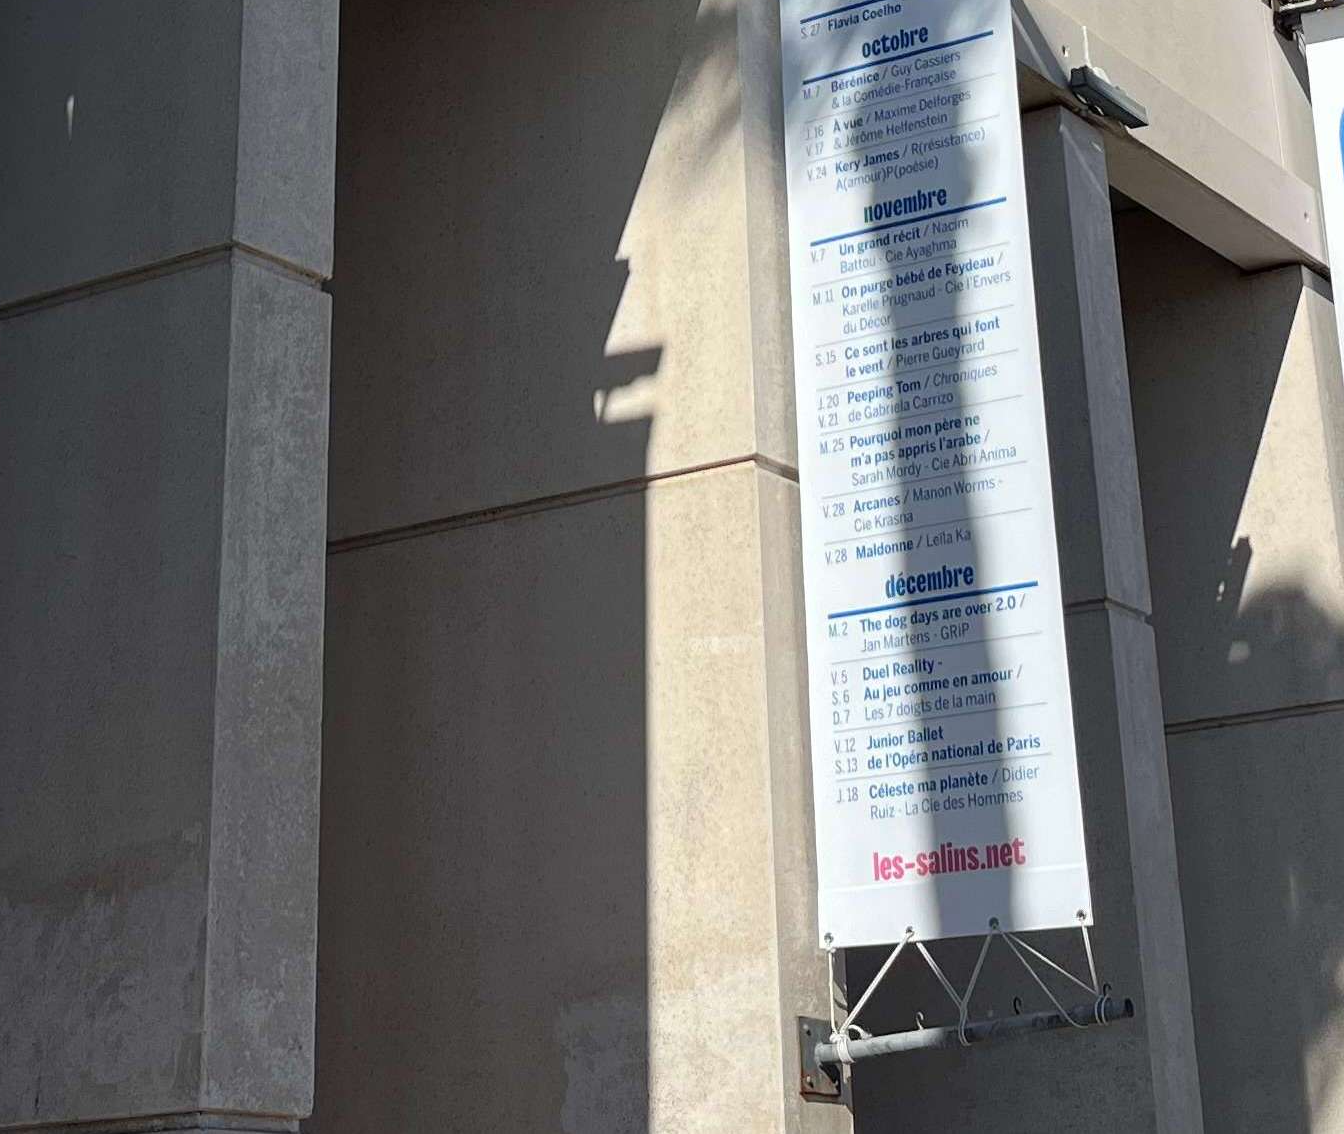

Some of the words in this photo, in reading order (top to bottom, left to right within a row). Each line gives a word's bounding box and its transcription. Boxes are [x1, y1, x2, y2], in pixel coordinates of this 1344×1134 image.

[827, 14, 859, 31] Flavia
[861, 3, 901, 21] Coelho
[861, 26, 928, 58] octobre
[830, 72, 879, 93] Bérénice
[890, 64, 911, 77] Guy
[913, 51, 960, 71] Cassiers
[843, 117, 863, 130] vue
[873, 104, 916, 122] Maxime
[844, 128, 883, 147] Jérôme
[835, 159, 860, 174] Kery
[862, 149, 899, 167] James
[863, 188, 946, 223] novembre
[838, 242, 854, 256] Un
[857, 235, 890, 254] grand
[893, 226, 920, 243] récit
[931, 217, 968, 235] Nacim
[884, 249, 903, 263] Cie
[841, 285, 857, 298] On
[860, 279, 893, 297] purge
[895, 268, 924, 286] bébé
[927, 266, 942, 279] de
[944, 256, 994, 276] Feydeau
[841, 297, 878, 316] Karelle
[944, 279, 964, 294] Cie
[966, 270, 1011, 289] l'Envers
[842, 320, 856, 334] du
[859, 314, 890, 331] Décor
[844, 346, 859, 360] Ce
[862, 339, 887, 356] sont
[891, 337, 908, 350] les
[911, 329, 949, 346] arbres
[952, 324, 971, 338] qui
[974, 315, 1000, 332] font
[845, 365, 856, 378] le
[858, 359, 883, 375] vent
[895, 351, 929, 367] Pierre
[847, 385, 893, 404] Peeping
[895, 380, 921, 394] Tom
[932, 363, 997, 387] Chroniques
[847, 409, 861, 423] de
[863, 399, 910, 419] Gabriela
[912, 392, 953, 409] Carrizo
[849, 426, 901, 449] Pourquoi
[904, 423, 931, 438] mon
[934, 418, 961, 434] père
[964, 415, 979, 426] ne
[850, 452, 871, 467] m'a
[874, 449, 895, 465] pas
[898, 441, 936, 459] appris
[938, 432, 980, 450] l'arabe
[851, 468, 883, 486] Sarah
[930, 456, 949, 471] Cie
[853, 495, 900, 513] Arcanes
[912, 485, 952, 501] Manon
[953, 477, 995, 495] Worms
[853, 517, 872, 532] Cie
[855, 539, 913, 559] Maldonne
[954, 528, 971, 542] Ka
[884, 565, 973, 598] décembre
[859, 617, 881, 633] The
[884, 614, 907, 629] dog
[910, 610, 939, 625] days
[941, 606, 961, 620] are
[964, 602, 992, 616] over
[995, 594, 1016, 611] 2.0
[860, 638, 881, 652] Jan
[883, 631, 930, 648] Martens
[862, 663, 889, 681] Duel
[892, 658, 934, 676] Reality
[863, 686, 879, 701] Au
[903, 678, 949, 694] comme
[952, 675, 968, 687] en
[971, 669, 1013, 685] amour
[864, 706, 884, 721] Les
[886, 702, 893, 718] 7
[895, 699, 931, 717] doigts
[933, 695, 949, 711] de
[965, 691, 996, 706] main
[866, 733, 904, 750] Junior
[907, 725, 943, 744] Ballet
[867, 755, 882, 769] de
[885, 749, 928, 768] l'Opéra
[931, 740, 983, 761] national
[987, 739, 1002, 754] de
[1006, 734, 1040, 751] Paris
[868, 781, 914, 799] Céleste
[917, 779, 936, 792] ma
[939, 771, 988, 790] planète
[1001, 765, 1039, 782] Didier
[870, 804, 894, 819] Ruiz
[904, 801, 918, 816] La
[921, 797, 940, 813] Cie
[942, 796, 965, 810] des
[967, 790, 1023, 807] Hommes
[872, 837, 1025, 881] les-salins.net
